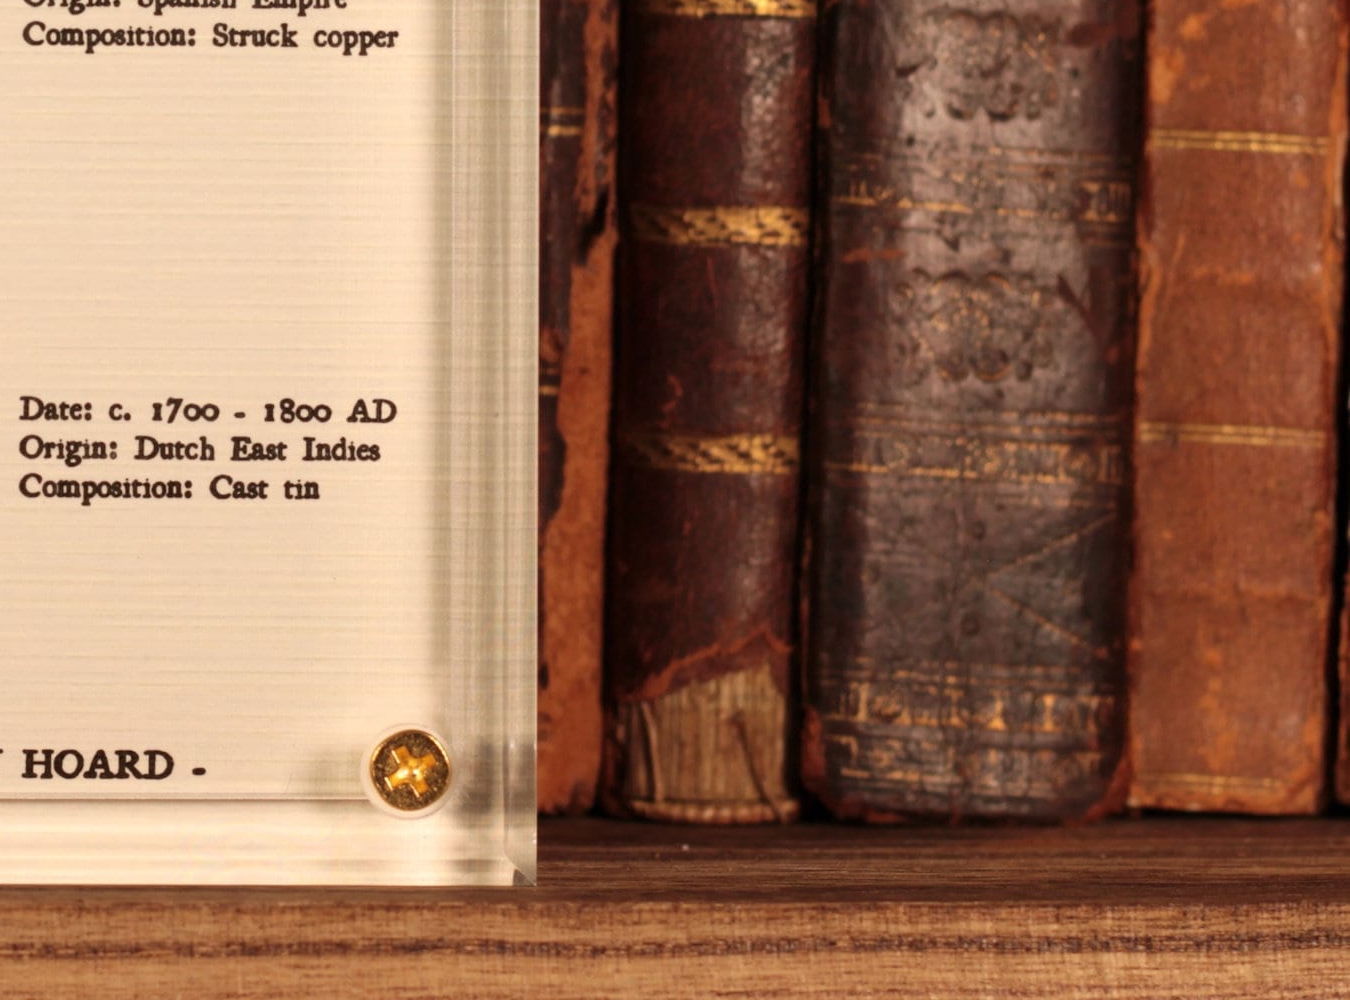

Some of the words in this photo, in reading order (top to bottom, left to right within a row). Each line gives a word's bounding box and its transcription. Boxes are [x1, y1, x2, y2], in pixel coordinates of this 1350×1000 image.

[22, 20, 196, 55] Composition:
[212, 22, 299, 48] Struck
[313, 29, 399, 56] copper
[19, 395, 92, 422] Date:
[108, 403, 132, 422] c.
[151, 397, 220, 424] 1700
[233, 411, 246, 419] -
[264, 397, 333, 424] 1800
[346, 398, 398, 424] AD
[18, 434, 118, 468] Origin:
[133, 435, 216, 461] Dutch
[230, 436, 288, 462] East
[301, 436, 381, 462] Indies
[18, 472, 193, 507] Composition:
[209, 474, 269, 500] Cast
[283, 479, 321, 500] tin
[21, 748, 175, 781] HOARD
[191, 767, 207, 776] -
